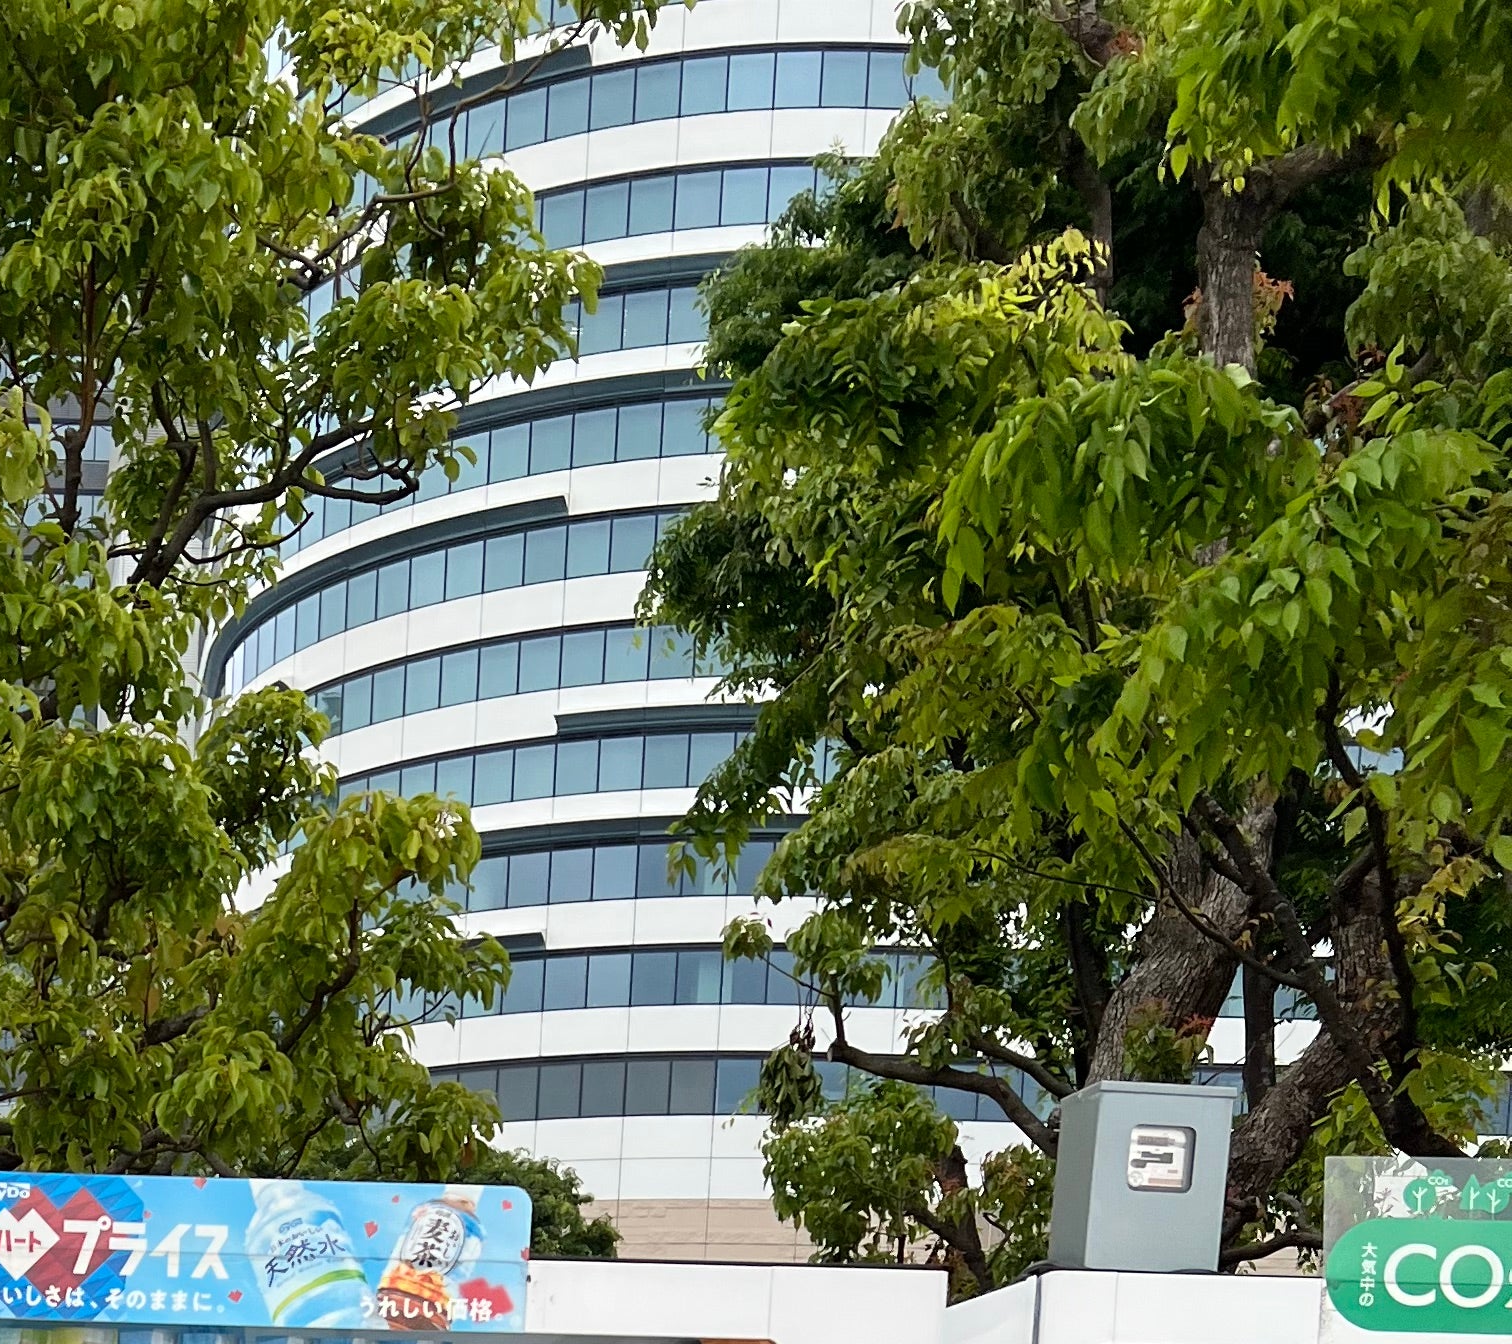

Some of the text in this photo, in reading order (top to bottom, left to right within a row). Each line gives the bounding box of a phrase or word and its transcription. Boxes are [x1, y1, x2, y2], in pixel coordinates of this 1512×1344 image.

[63, 1216, 229, 1280] プライス
[265, 1234, 345, 1287] 天然水
[412, 1219, 450, 1268] 麦茶
[1359, 1242, 1378, 1307] 大気中の
[1384, 1243, 1512, 1310] CO
[360, 1297, 504, 1322] うれしい価格。
